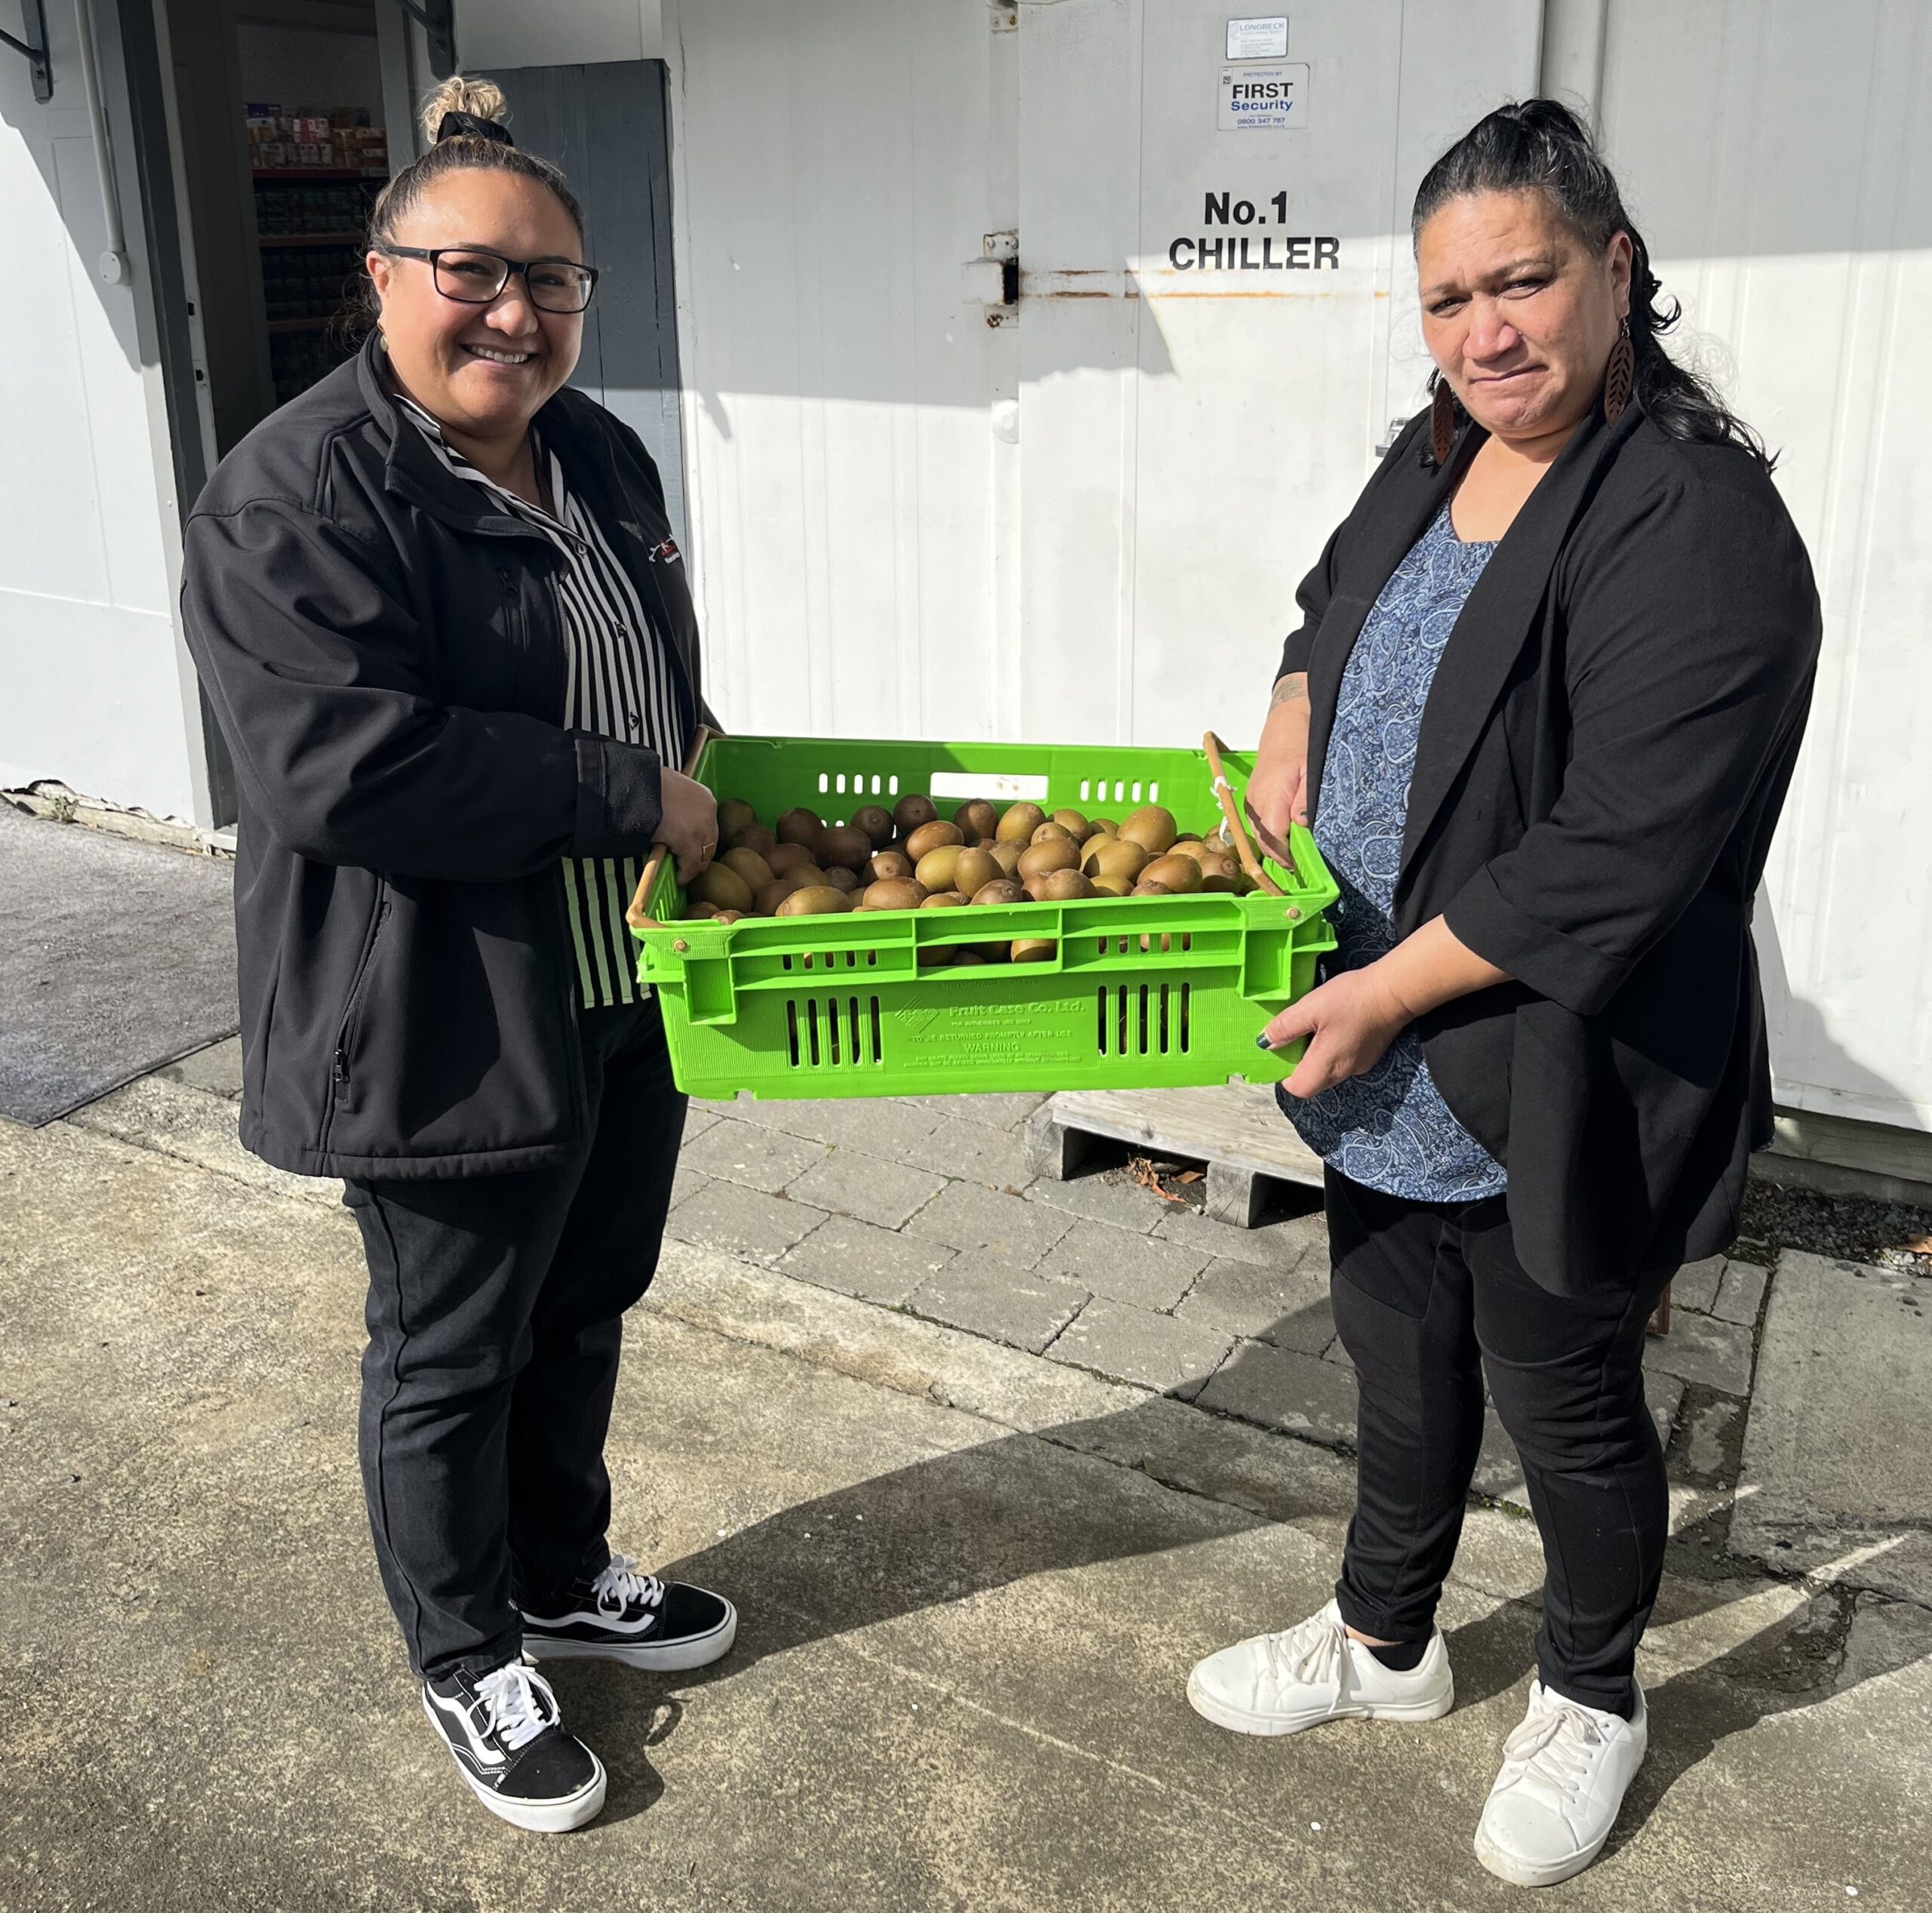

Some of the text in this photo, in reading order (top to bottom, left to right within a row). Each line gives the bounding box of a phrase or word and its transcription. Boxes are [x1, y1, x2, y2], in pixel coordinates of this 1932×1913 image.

[1239, 23, 1284, 31] LONGBECK
[1232, 82, 1294, 99] FIRST
[1231, 100, 1294, 112] Security
[1204, 191, 1287, 225] No.1
[1169, 236, 1340, 270] CHILLER
[949, 1001, 1085, 1016] Fruit Case Co. Ltd.
[940, 1033, 982, 1041] RETURNED
[985, 1031, 1025, 1039] PROMPTLY
[1027, 1030, 1054, 1038] AFTER
[1056, 1029, 1072, 1038] USE
[965, 1042, 1020, 1053] WARNING
